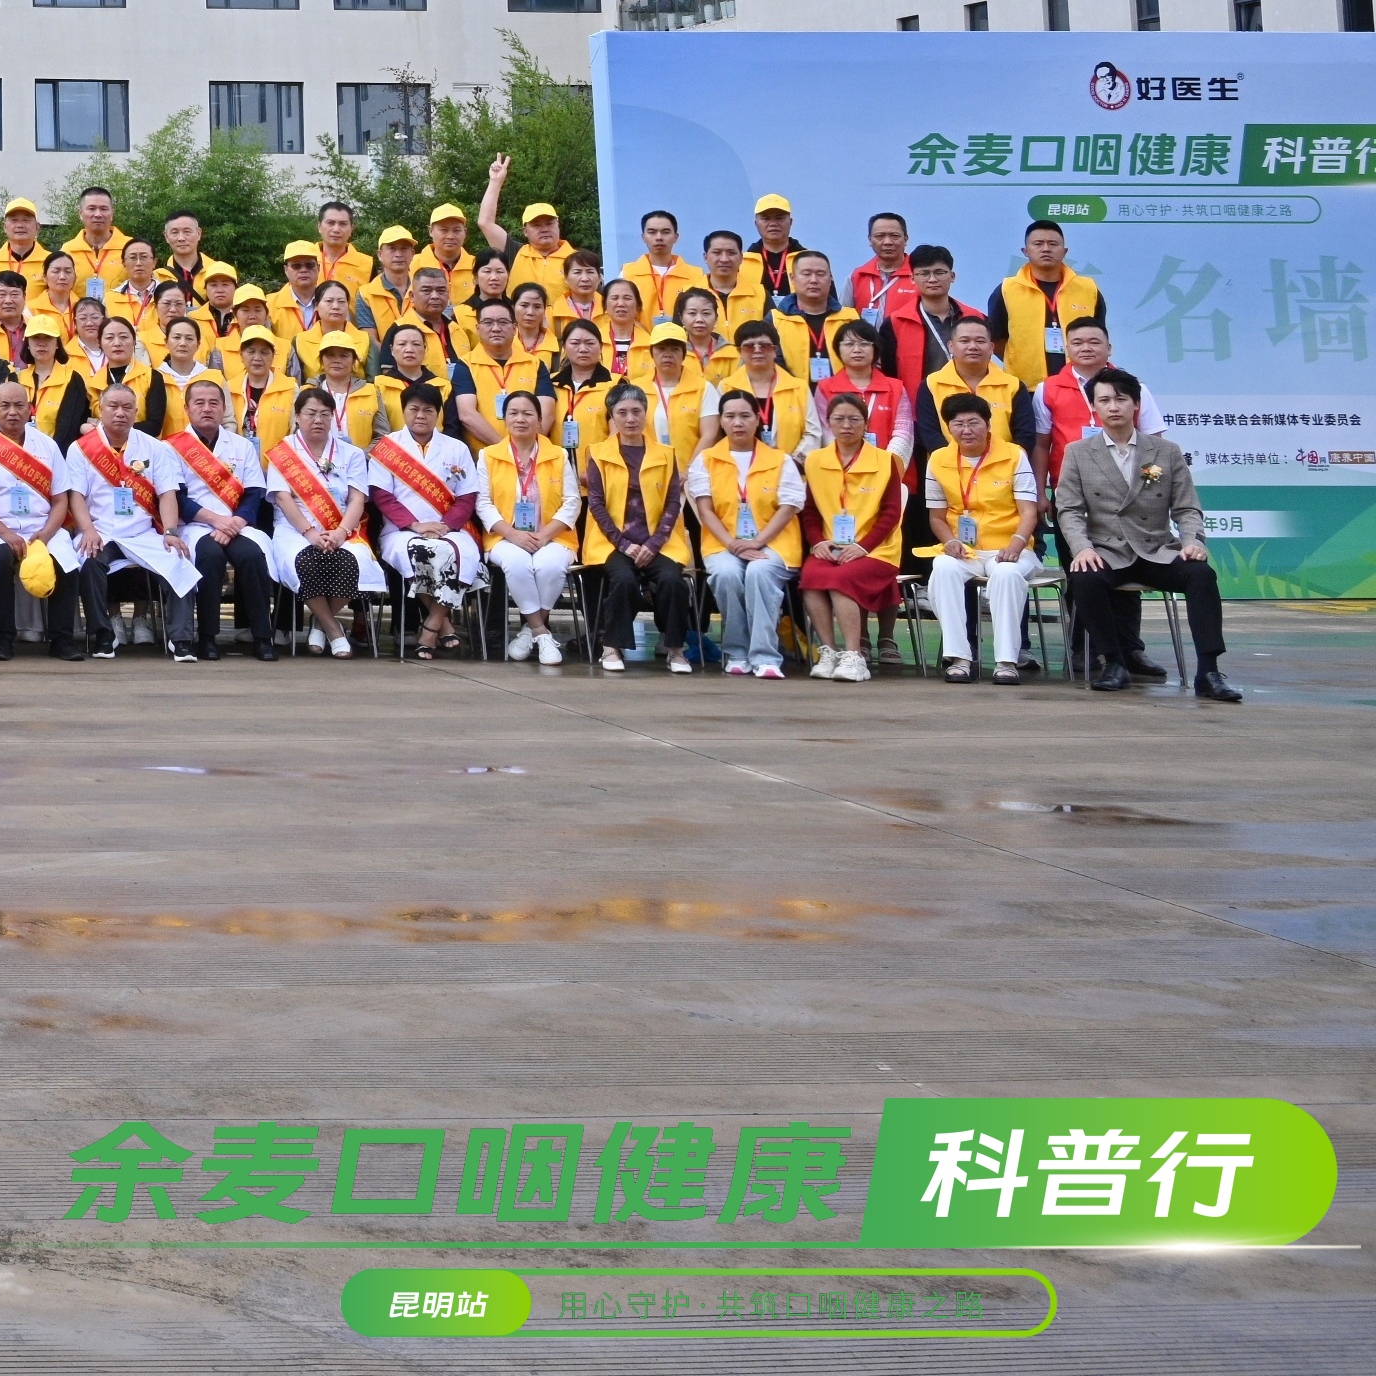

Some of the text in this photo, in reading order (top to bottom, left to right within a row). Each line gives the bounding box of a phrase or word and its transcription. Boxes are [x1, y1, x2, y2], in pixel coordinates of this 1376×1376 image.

[1136, 77, 1239, 101] 好医生
[907, 132, 1232, 177] 余麦口咽健康
[1047, 204, 1090, 216] 昆明站
[1118, 204, 1292, 217] 用心守护·共筑口咽健康之路
[1163, 413, 1361, 426] 中医药学会联合会新媒体专业委员会
[1205, 452, 1289, 465] 媒体支持单位：
